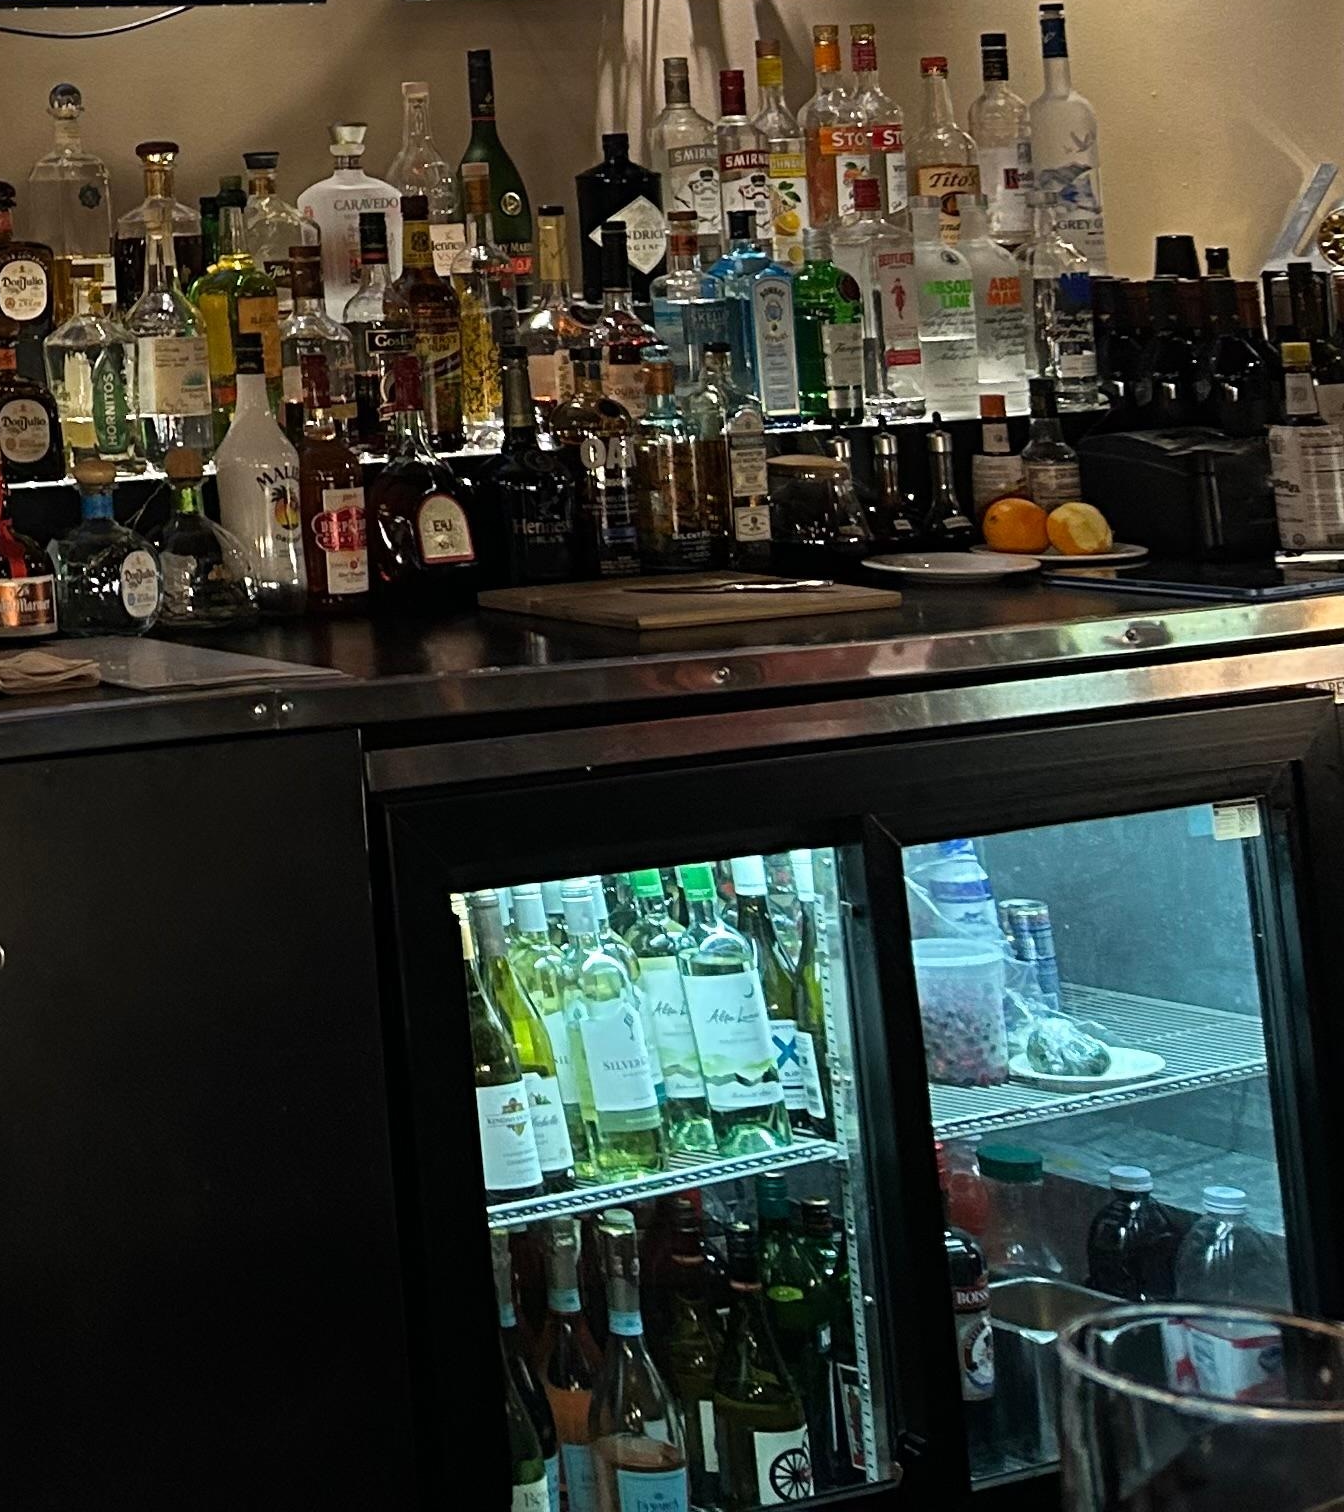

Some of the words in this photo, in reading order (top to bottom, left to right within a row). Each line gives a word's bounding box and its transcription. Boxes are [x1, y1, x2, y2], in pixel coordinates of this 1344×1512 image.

[929, 171, 979, 188] Tito's
[333, 197, 400, 211] CARAVEDO
[106, 372, 117, 446] HORNITOS
